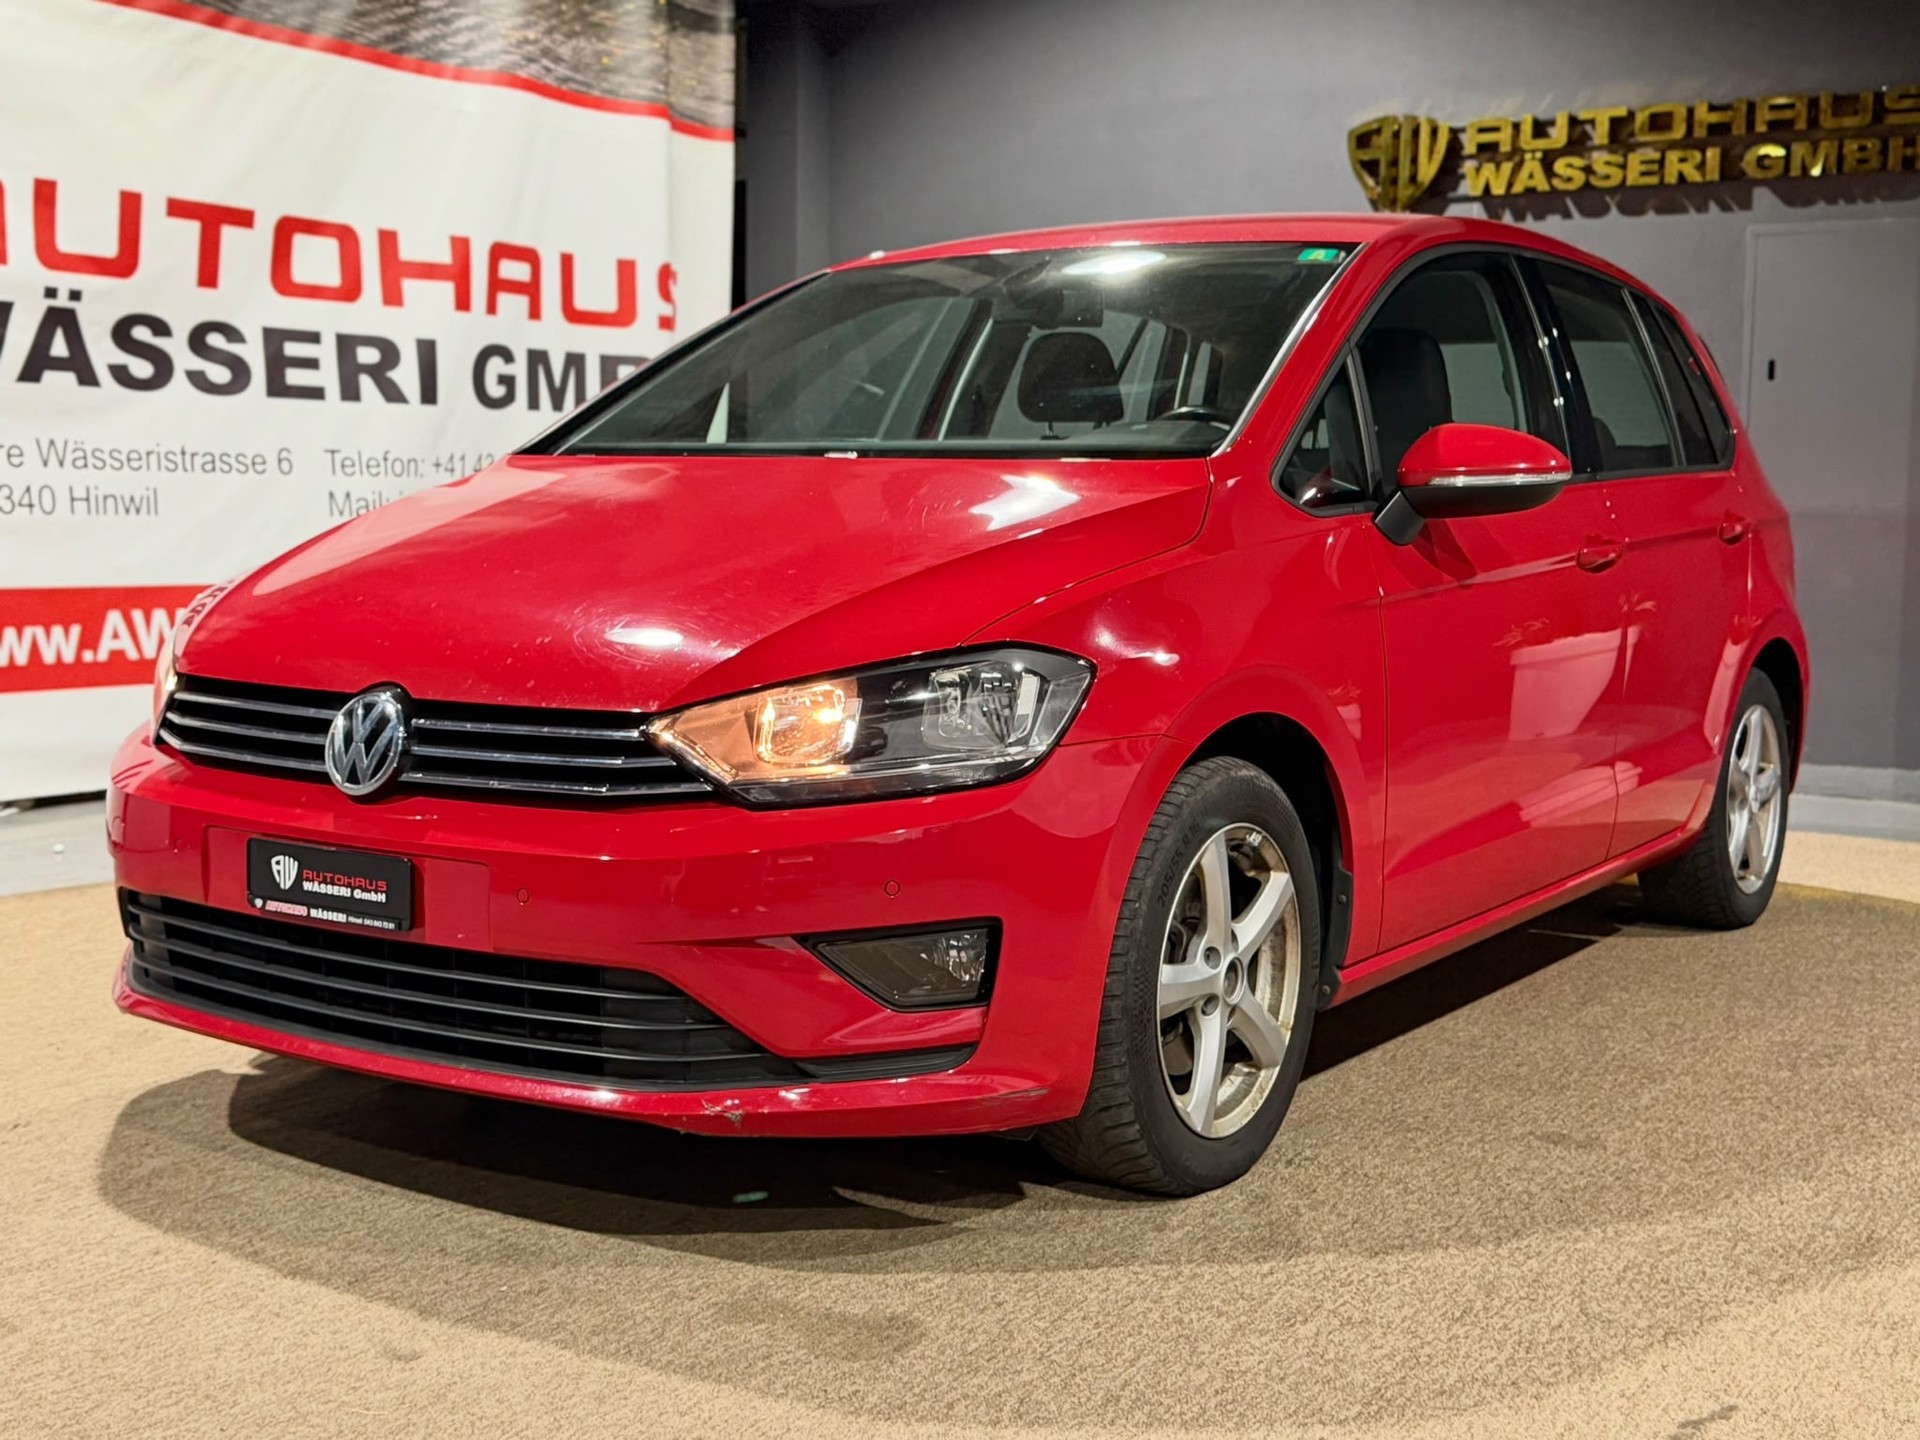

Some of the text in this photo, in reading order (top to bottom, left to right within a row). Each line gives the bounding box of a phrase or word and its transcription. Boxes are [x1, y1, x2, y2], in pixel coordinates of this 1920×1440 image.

[1464, 83, 1920, 156] AUTOHAUS
[1465, 146, 1722, 197] WÄSSERI
[0, 286, 440, 406] ÄSSERI
[35, 437, 268, 475] Wässeristrasse
[276, 447, 294, 476] 6
[324, 448, 425, 479] Telefon:
[69, 484, 159, 516] Hinwil
[302, 879, 387, 903] WÄSSERI GmbH
[303, 869, 387, 890] AUTOHAUS
